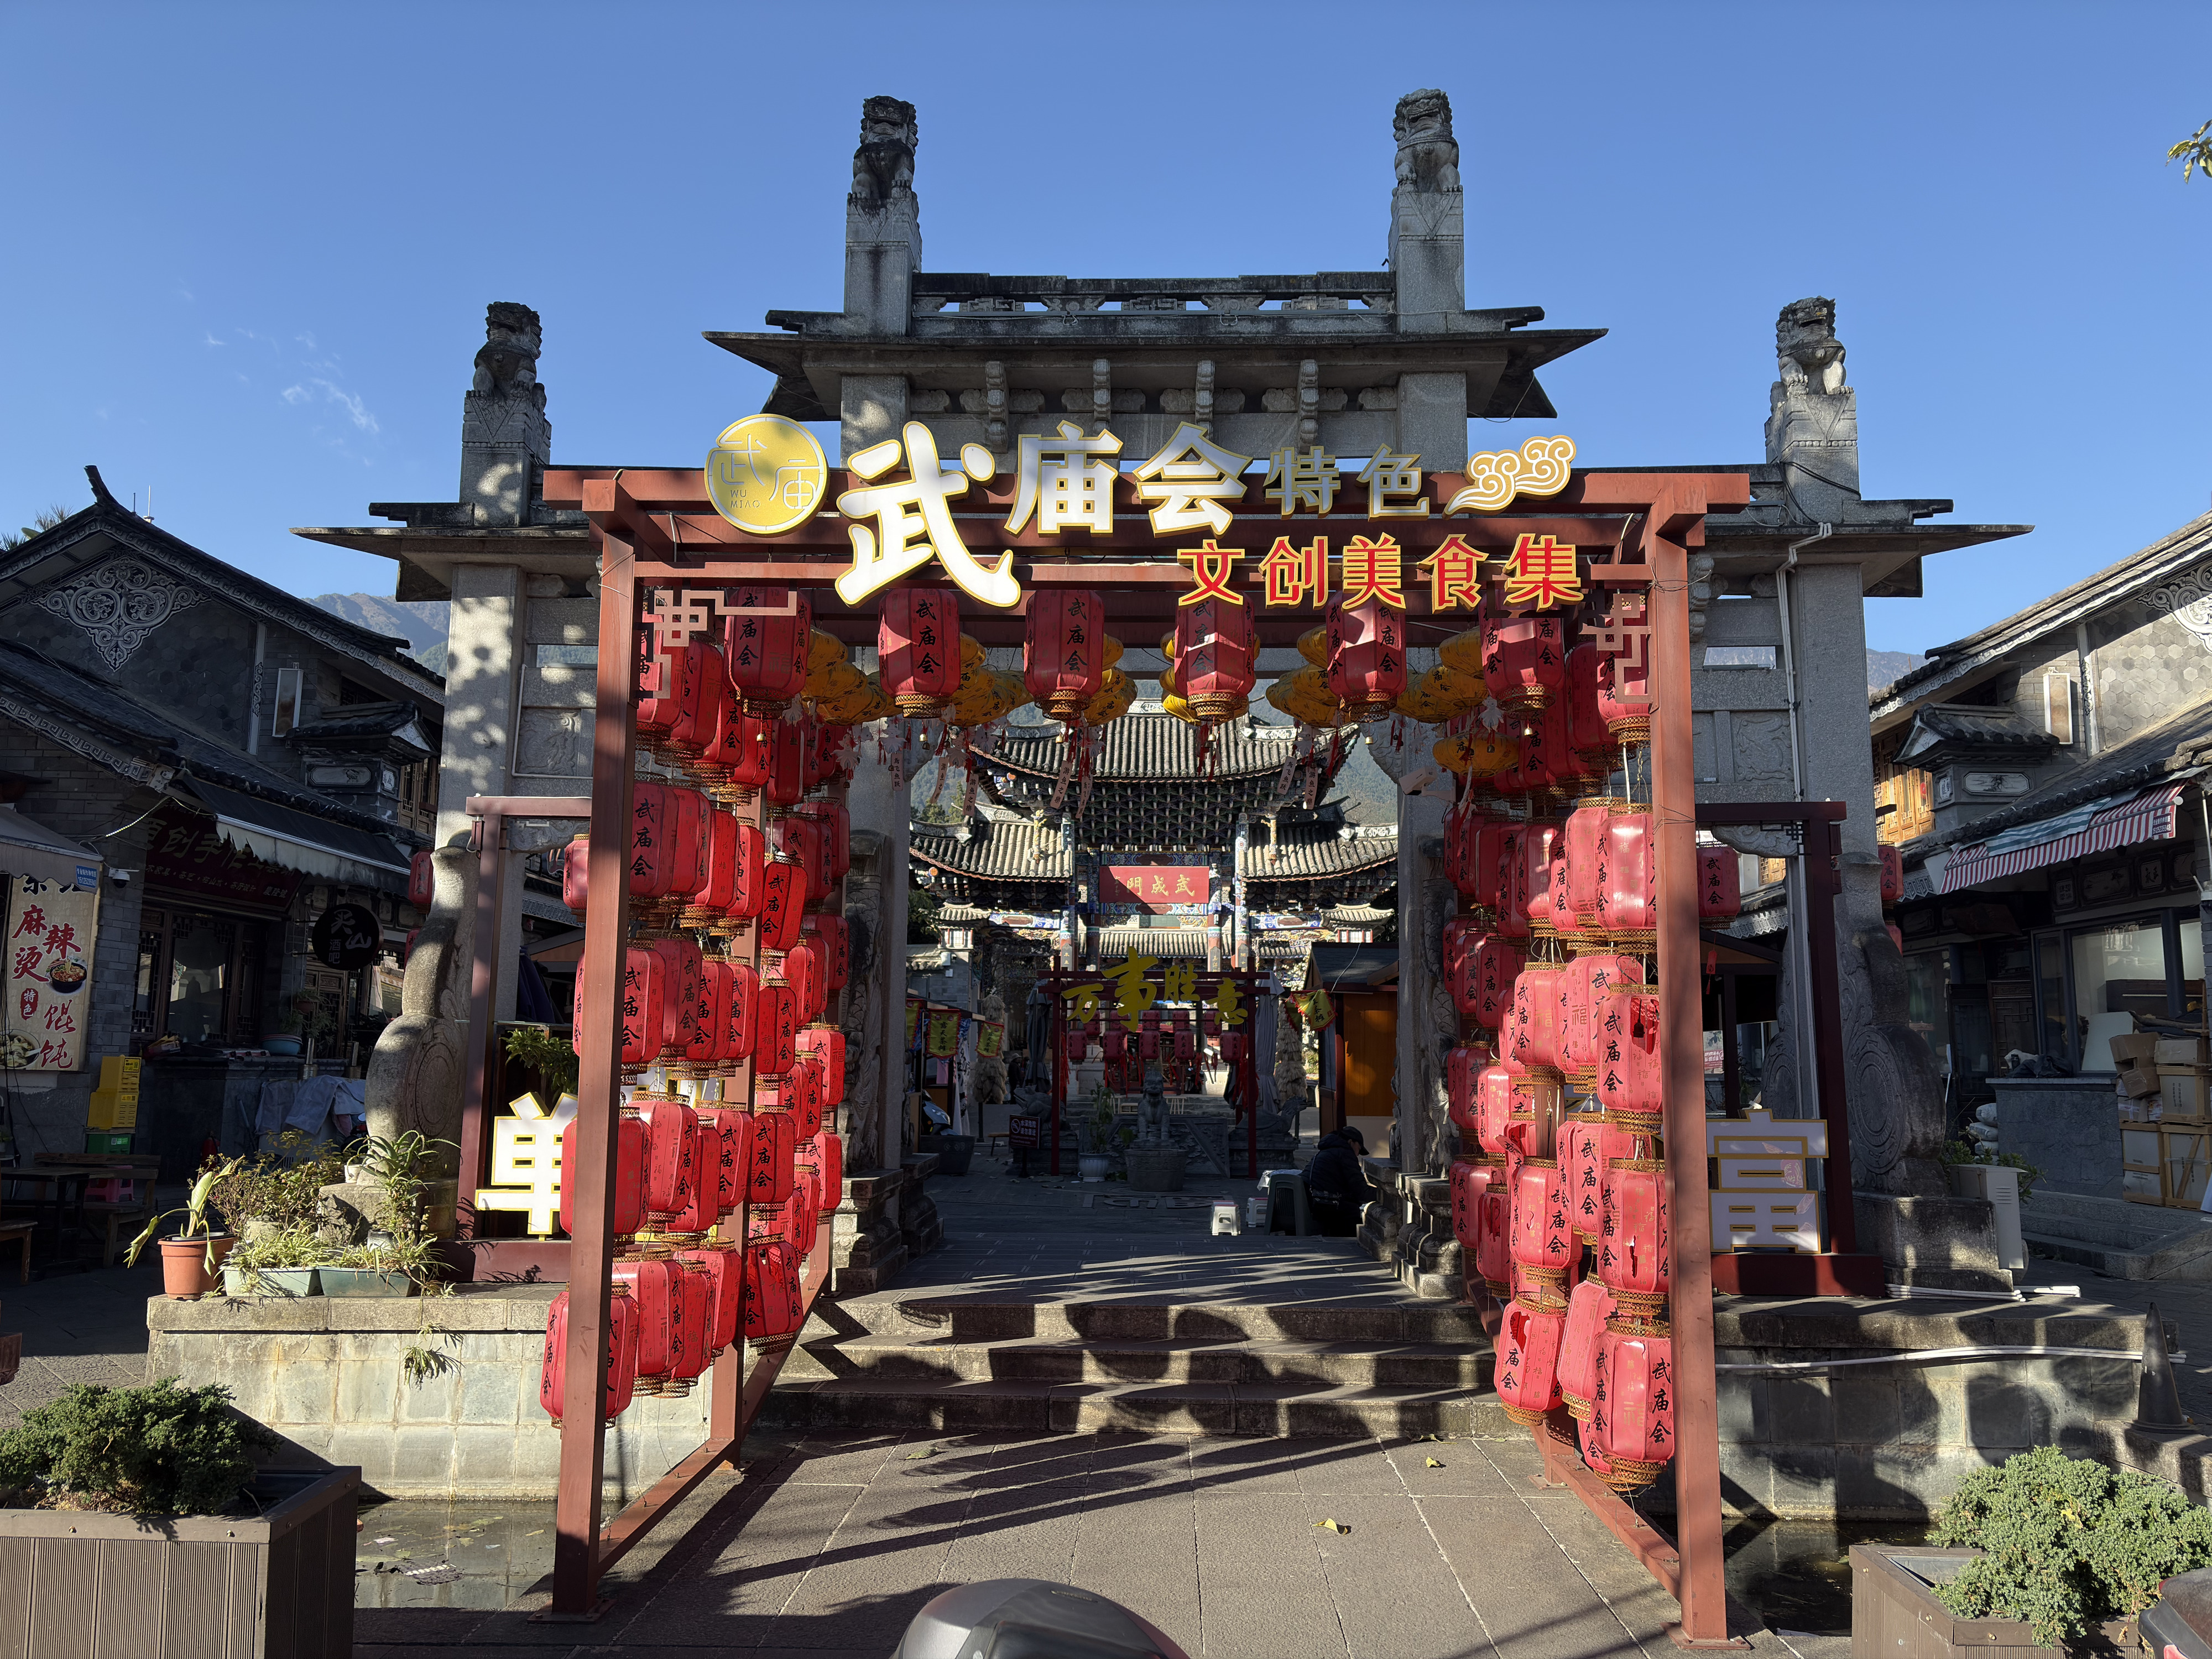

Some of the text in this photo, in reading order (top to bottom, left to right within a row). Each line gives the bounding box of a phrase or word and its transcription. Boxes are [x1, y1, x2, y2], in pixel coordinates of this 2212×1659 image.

[730, 489, 747, 499] WU
[730, 499, 760, 509] MIAO
[1177, 532, 1584, 614] 文创美食集
[793, 604, 808, 675] 武庙会
[916, 598, 941, 674] 武庙会
[1065, 598, 1088, 673] 武庙会
[1191, 601, 1213, 672] 武庙会
[1329, 606, 1344, 675] 武庙会
[1378, 605, 1399, 673] 武庙会
[1538, 618, 1559, 666] 庙会
[821, 726, 833, 763] 庙会
[630, 797, 655, 877] 武庙会
[698, 803, 709, 877] 武庙会
[822, 832, 832, 885] 武庙会
[1459, 827, 1468, 881] 武庙会
[1517, 840, 1525, 902] 武庙会
[1883, 852, 1896, 889] 武庙会
[762, 874, 784, 934] 武庙会
[1499, 862, 1509, 922] 武庙会
[1597, 833, 1609, 912] 武庙会
[1707, 857, 1724, 905] 武庙会
[12, 904, 82, 983] 麻辣烫
[328, 939, 342, 964] 酒吧
[836, 925, 847, 977] 武庙会
[1446, 930, 1455, 982] 武庙会
[23, 989, 34, 1018] 特色
[622, 966, 640, 1047] 武庙会
[680, 956, 697, 1030] 武庙会
[693, 974, 712, 1045] 武庙会
[804, 960, 813, 1014] 武庙会
[1061, 946, 1248, 1033] 万事胜意
[1482, 954, 1498, 1012] 武庙会
[1517, 983, 1530, 1049] 武庙会
[40, 999, 77, 1069] 馄饨
[778, 999, 793, 1061] 武庙会
[1603, 1010, 1624, 1092] 武庙会
[784, 1073, 796, 1111] 武庙
[807, 1069, 818, 1125] 武庙会
[641, 1137, 650, 1215] 武庙会
[677, 1120, 695, 1196] 武庙会
[719, 1125, 737, 1193] 武庙会
[754, 1123, 773, 1188] 武庙会
[1558, 1138, 1570, 1210] 武庙会
[1580, 1138, 1598, 1215] 武庙会
[1457, 1175, 1467, 1233] 武庙会
[1600, 1184, 1618, 1268] 武庙会
[671, 1275, 682, 1354] 武庙会
[745, 1284, 760, 1326] 庙会
[786, 1253, 801, 1317] 武庙会
[542, 1309, 556, 1395] 武庙会
[1595, 1347, 1609, 1433] 武庙会
[1649, 1357, 1672, 1444] 武庙会
